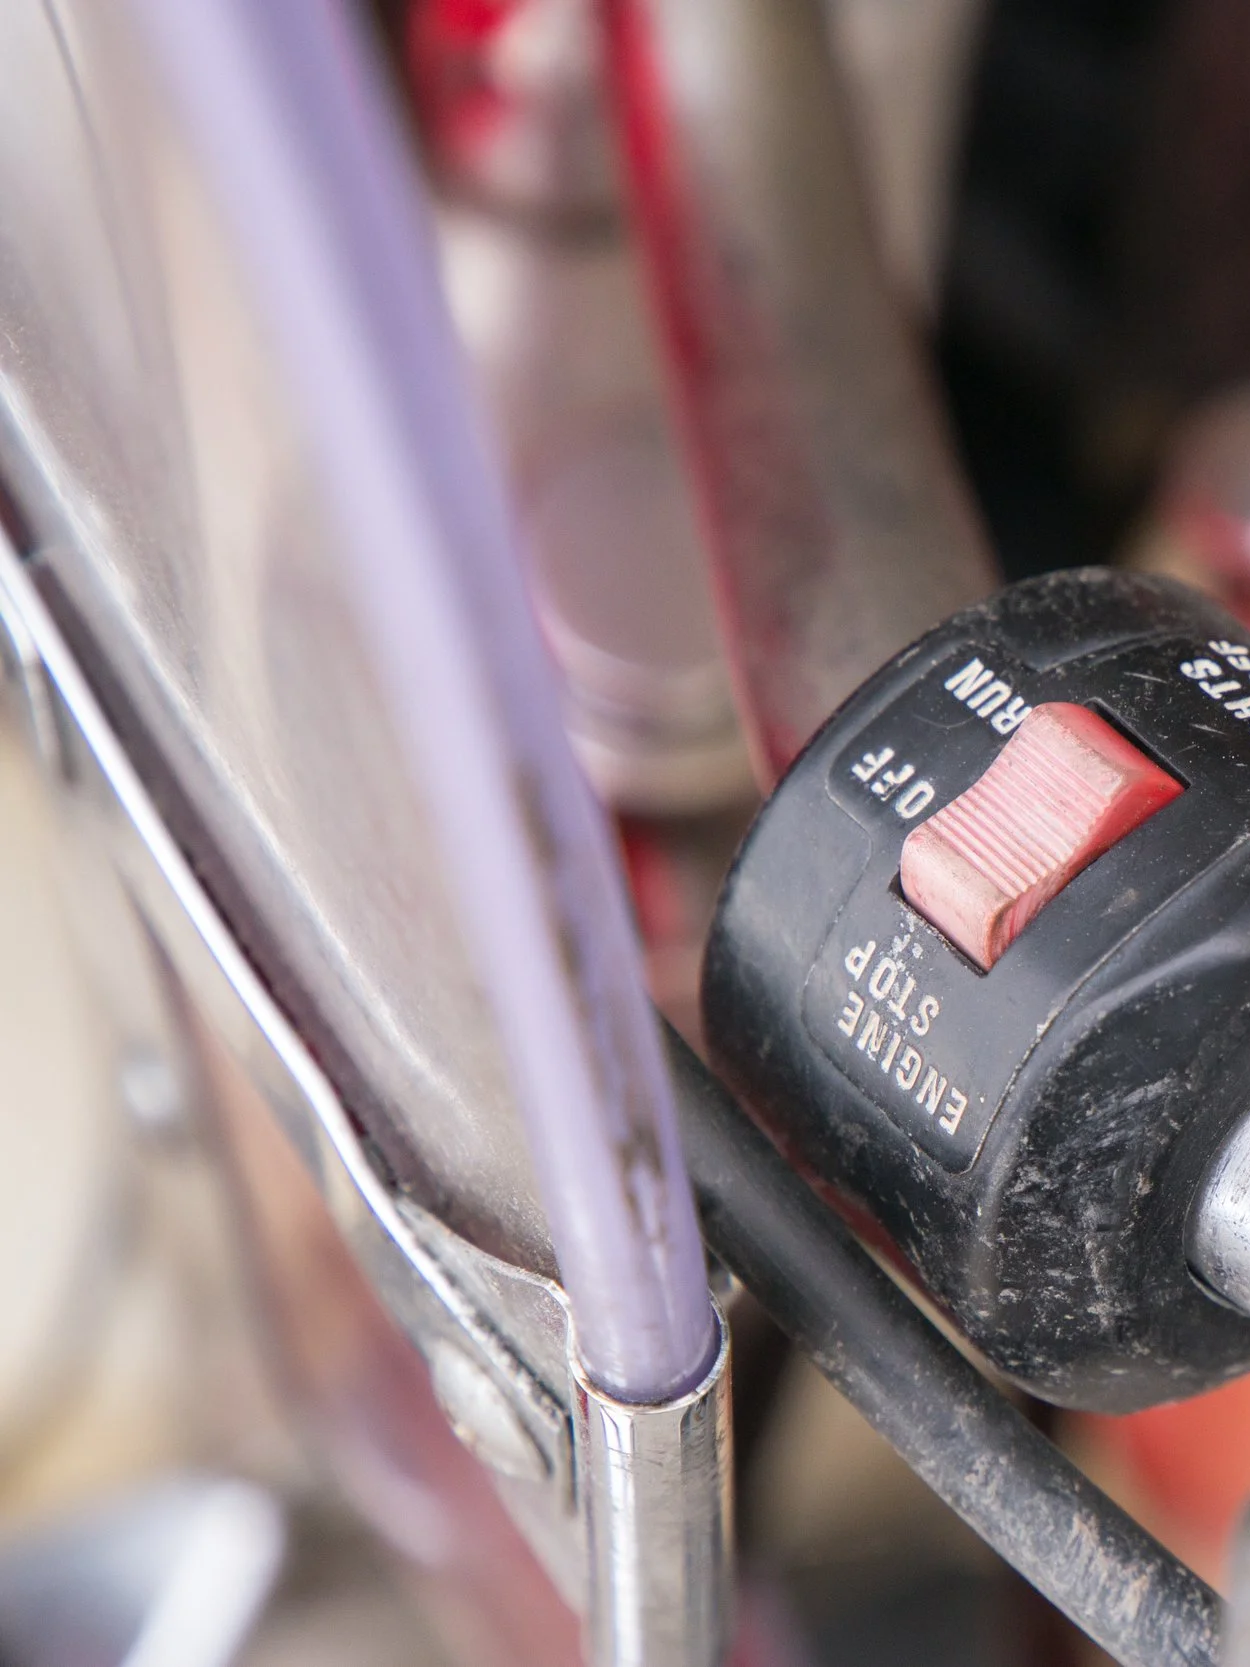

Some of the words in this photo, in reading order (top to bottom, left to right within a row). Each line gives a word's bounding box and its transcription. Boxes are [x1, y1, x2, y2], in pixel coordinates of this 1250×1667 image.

[943, 656, 1033, 736] RUN
[851, 747, 936, 820] OFF
[844, 939, 940, 1037] STOP
[837, 990, 968, 1136] ENGINE
